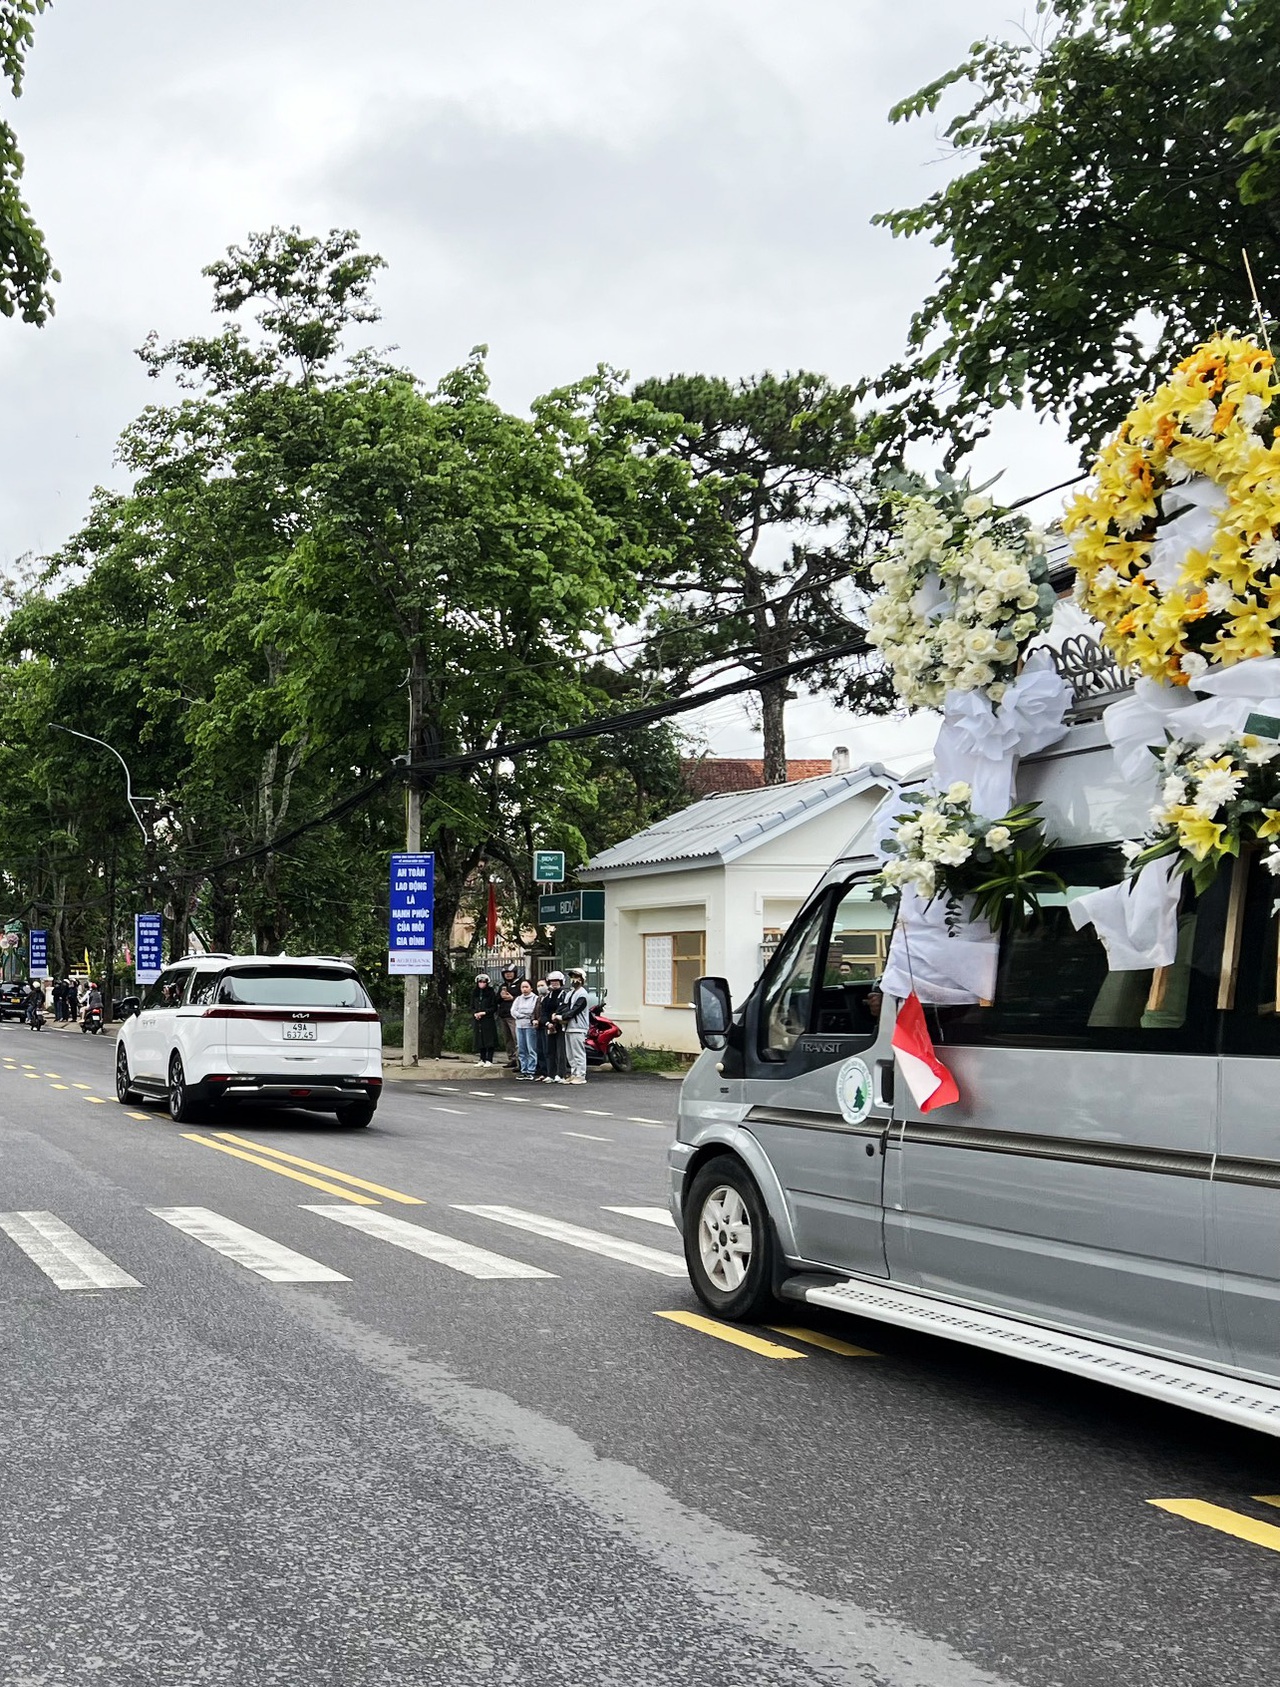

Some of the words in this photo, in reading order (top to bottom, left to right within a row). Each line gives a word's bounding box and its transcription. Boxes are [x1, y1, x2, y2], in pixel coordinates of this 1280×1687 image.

[397, 868, 407, 877] AN
[408, 866, 426, 877] TOÀN
[395, 882, 408, 891] LAO
[408, 880, 428, 893] ĐỘNG
[406, 894, 416, 905] LÀ
[560, 900, 575, 914] BIDV
[392, 909, 411, 920] HẠNH
[412, 907, 430, 919] PHÚC
[396, 920, 410, 932] CỦA
[396, 936, 408, 946] GIA
[408, 935, 426, 946] ĐÌNH
[801, 1042, 842, 1053] TRANSIT
